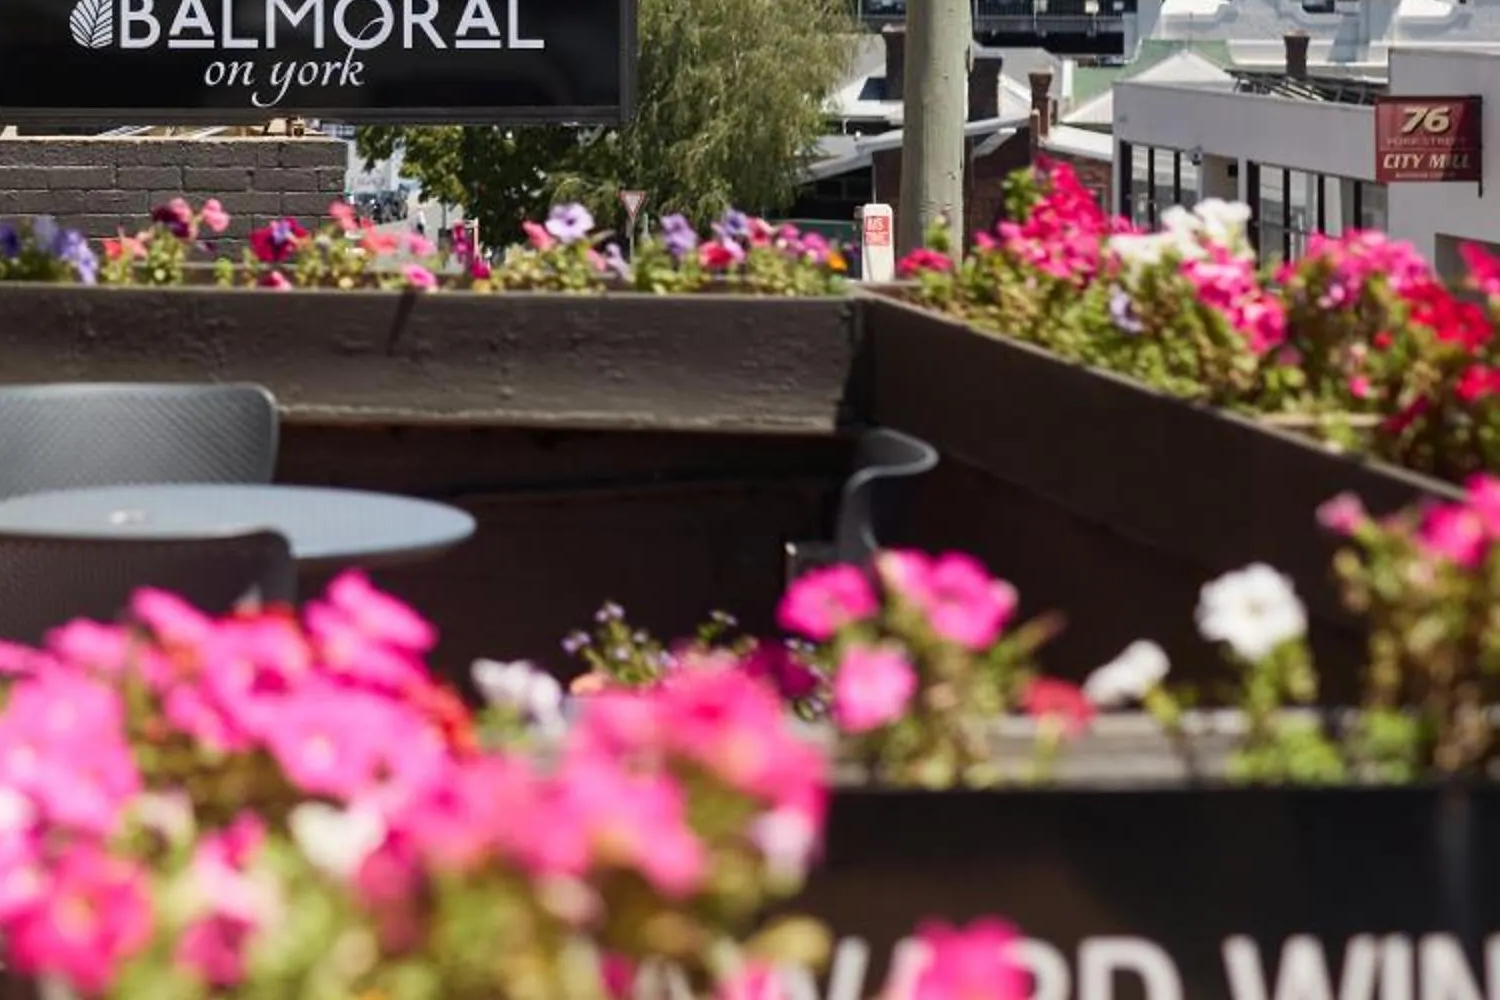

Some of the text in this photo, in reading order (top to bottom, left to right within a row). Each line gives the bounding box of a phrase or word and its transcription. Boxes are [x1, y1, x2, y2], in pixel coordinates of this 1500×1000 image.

[204, 48, 365, 107] on york
[1401, 106, 1450, 133] 76
[1383, 153, 1470, 169] CITY MILL
